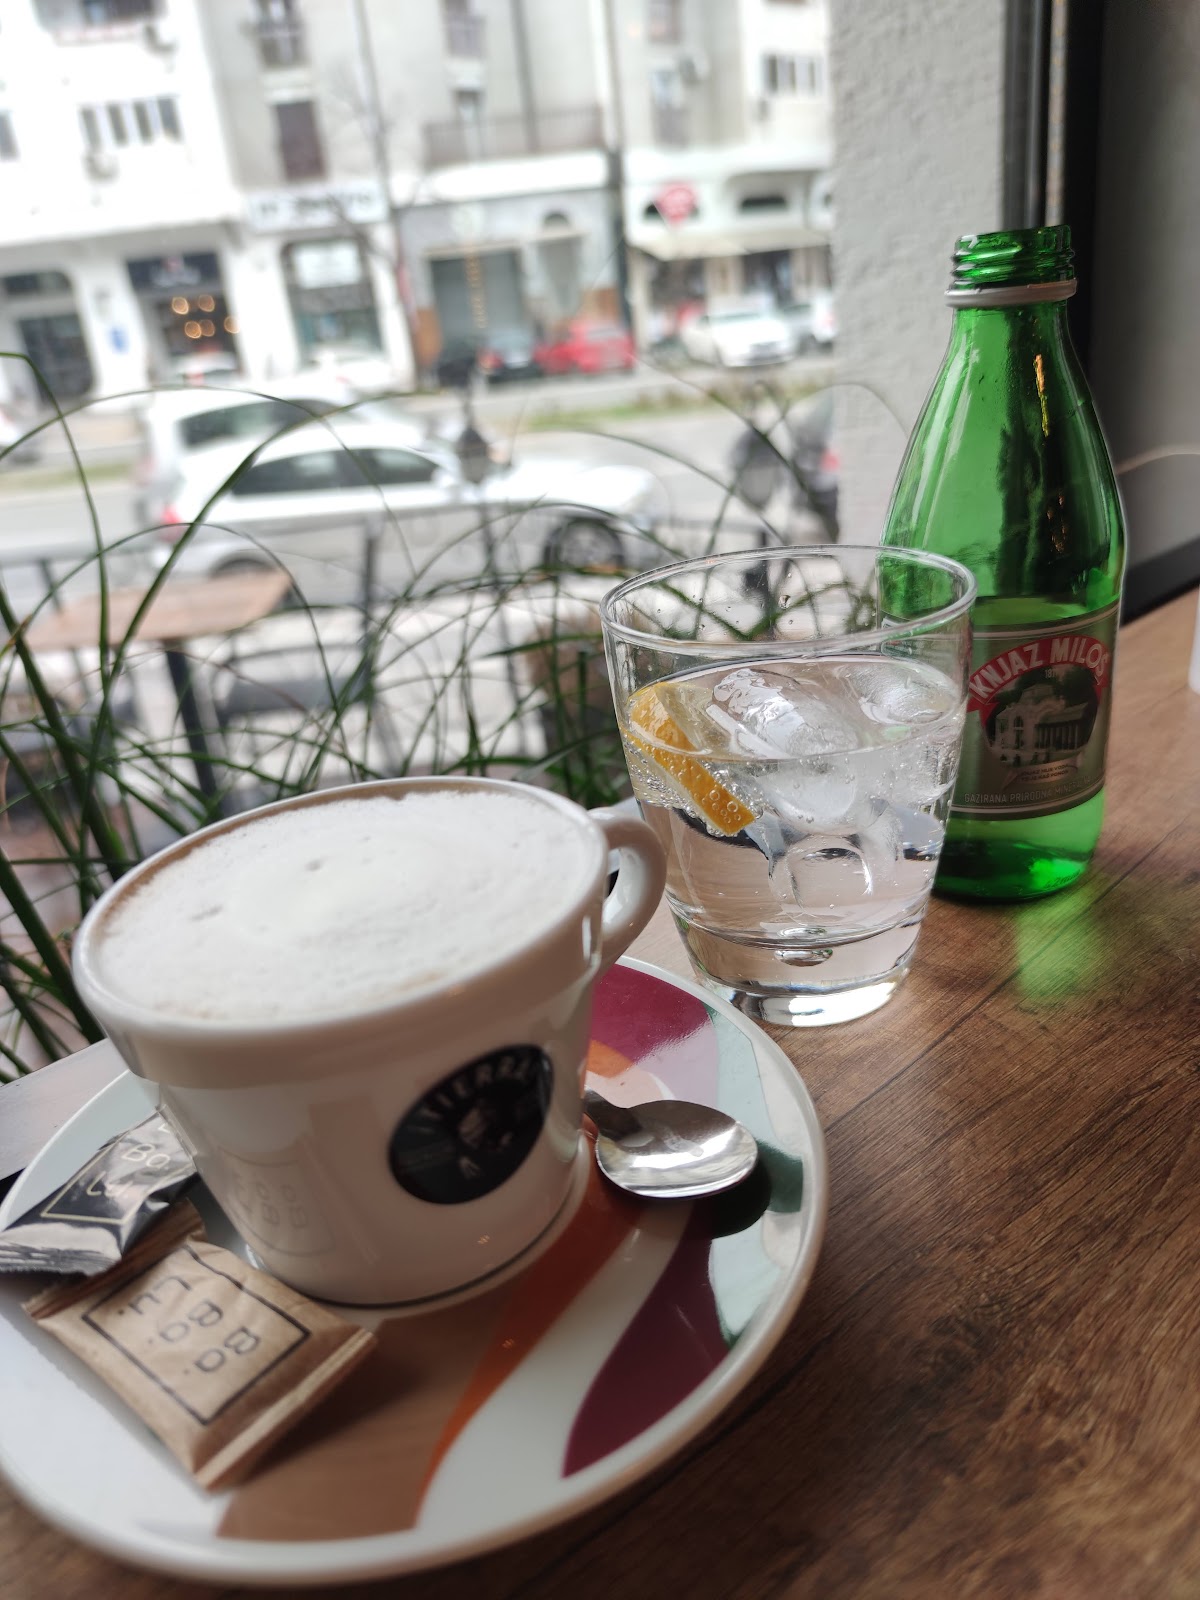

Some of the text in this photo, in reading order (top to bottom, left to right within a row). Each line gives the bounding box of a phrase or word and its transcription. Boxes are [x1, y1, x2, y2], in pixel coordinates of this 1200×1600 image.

[969, 642, 1043, 699] KNJAZ
[964, 792, 1007, 804] GAZIRANA
[1009, 789, 1052, 802] PRIRODNA
